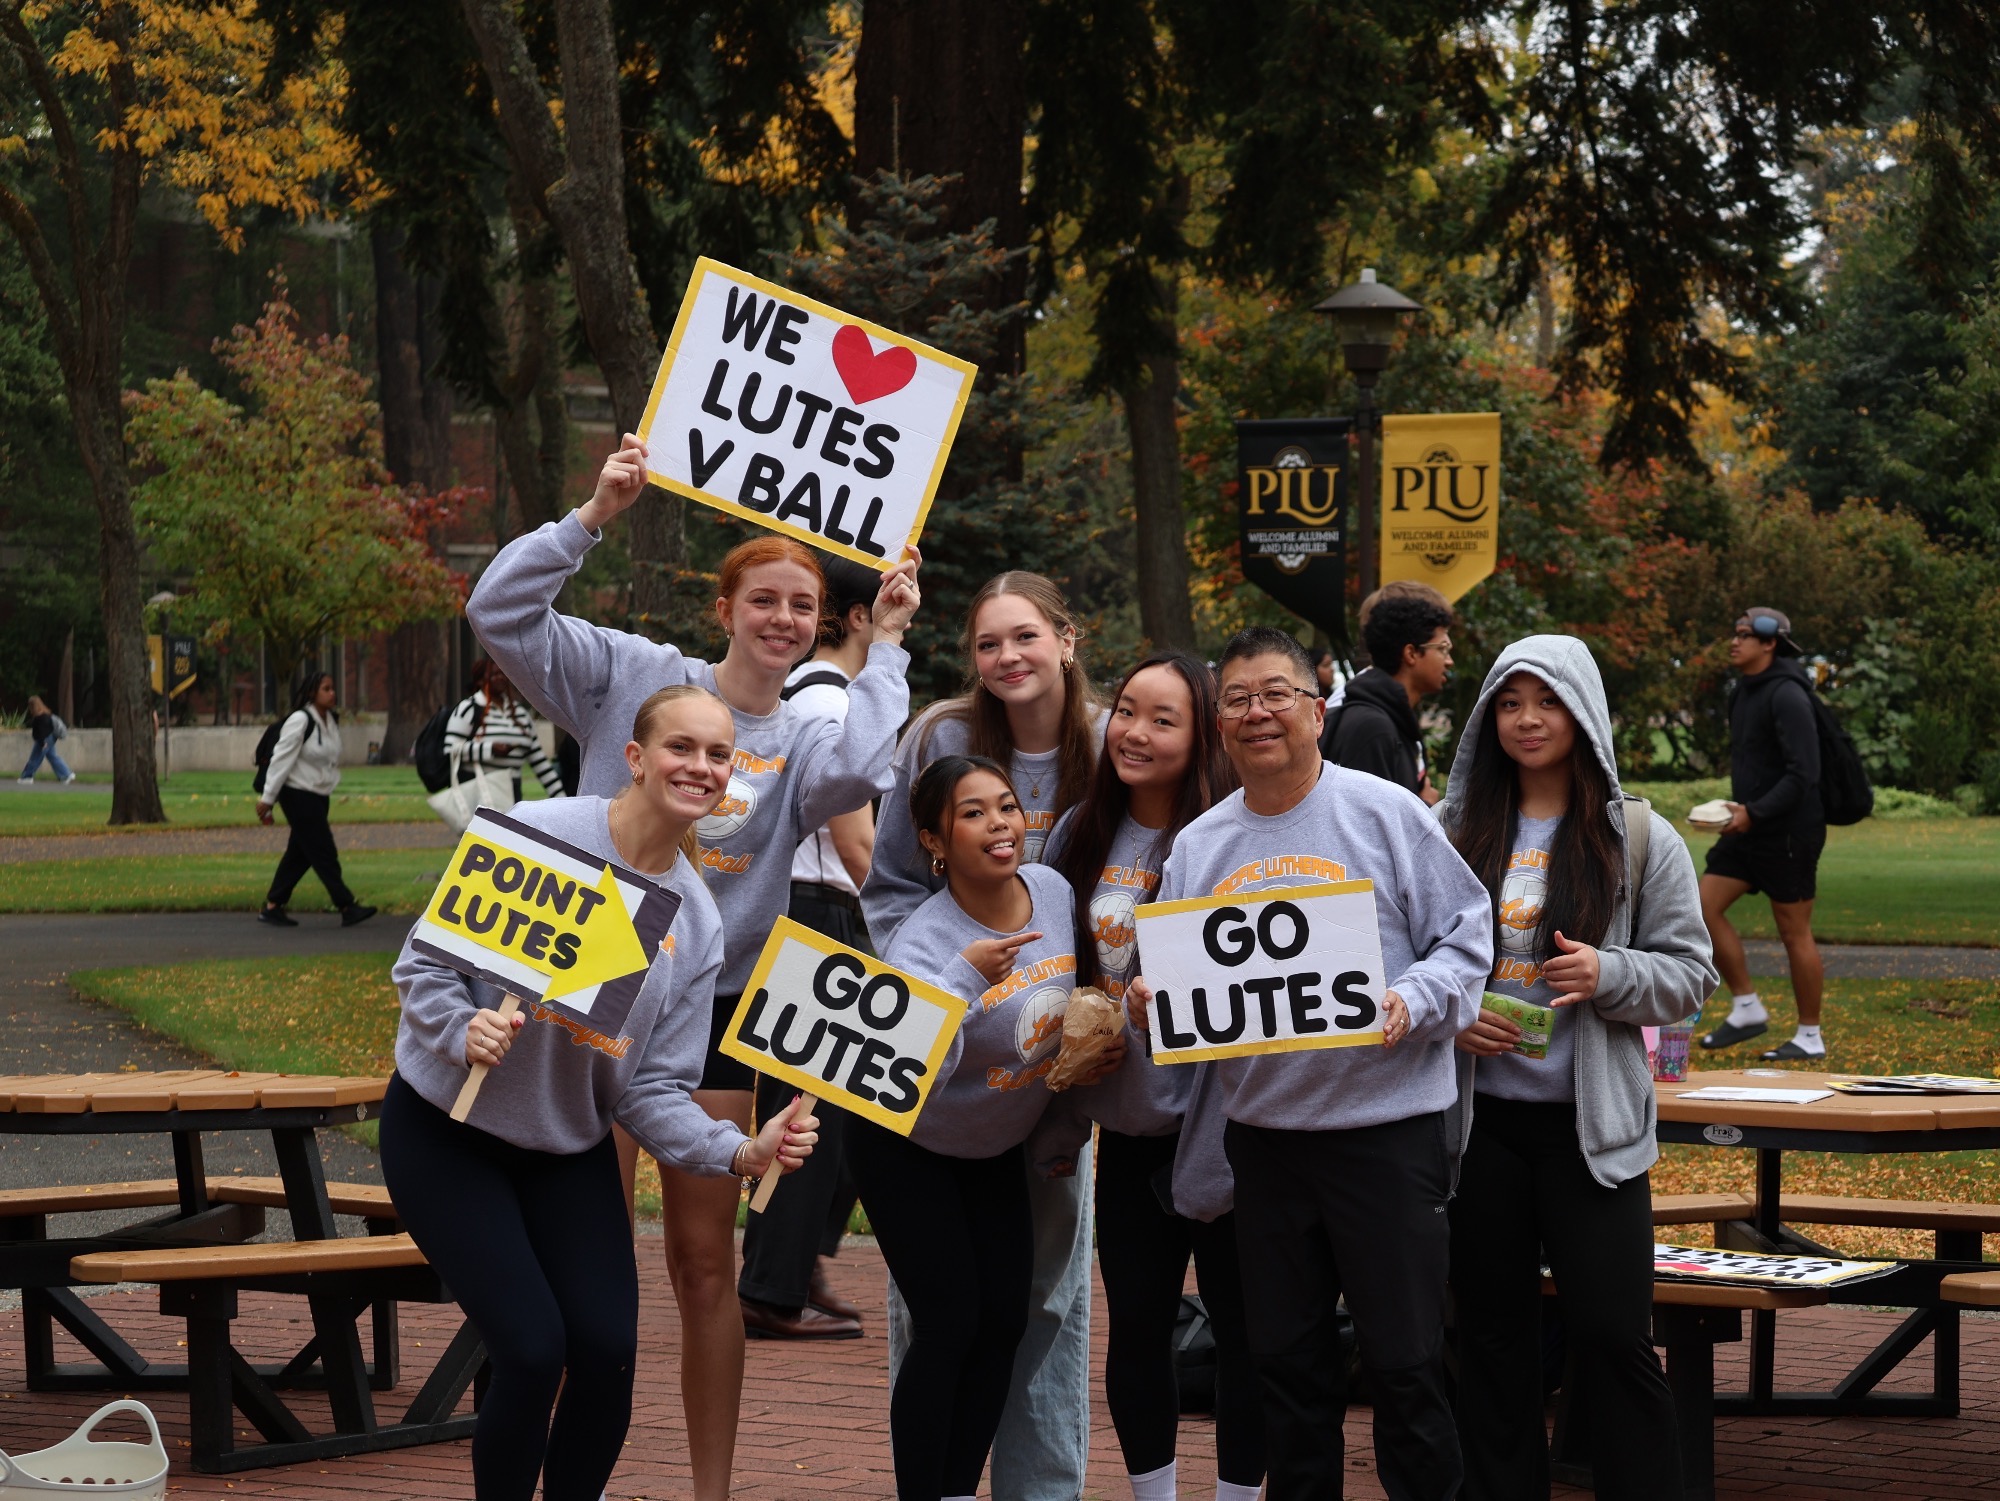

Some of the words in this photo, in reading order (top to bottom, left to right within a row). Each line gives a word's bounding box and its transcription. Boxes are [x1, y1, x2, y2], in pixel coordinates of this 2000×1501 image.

[722, 286, 809, 365] WE
[701, 358, 900, 479] LUTES
[689, 428, 735, 488] V
[738, 453, 886, 557] BALL
[1246, 466, 1340, 526] PLU
[1391, 465, 1489, 522] PLU
[1247, 532, 1296, 542] WELCOME
[1298, 531, 1339, 541] ALUMNI
[1259, 543, 1280, 553] AND
[1282, 542, 1328, 552] FAMILIES
[1392, 530, 1444, 540] WELCOME
[1448, 529, 1489, 539] ALUMNI
[1403, 542, 1427, 551] AND
[1429, 541, 1477, 551] FAMILIES
[459, 843, 606, 925] POINT
[1263, 854, 1347, 881] LUTHERAN
[438, 885, 582, 970] LUTES
[1203, 901, 1309, 967] GO
[813, 953, 910, 1030] GO
[1155, 970, 1376, 1049] LUTES
[737, 988, 928, 1113] LUTES
[1092, 1024, 1114, 1036] Laila
[1711, 1125, 1734, 1139] Frog
